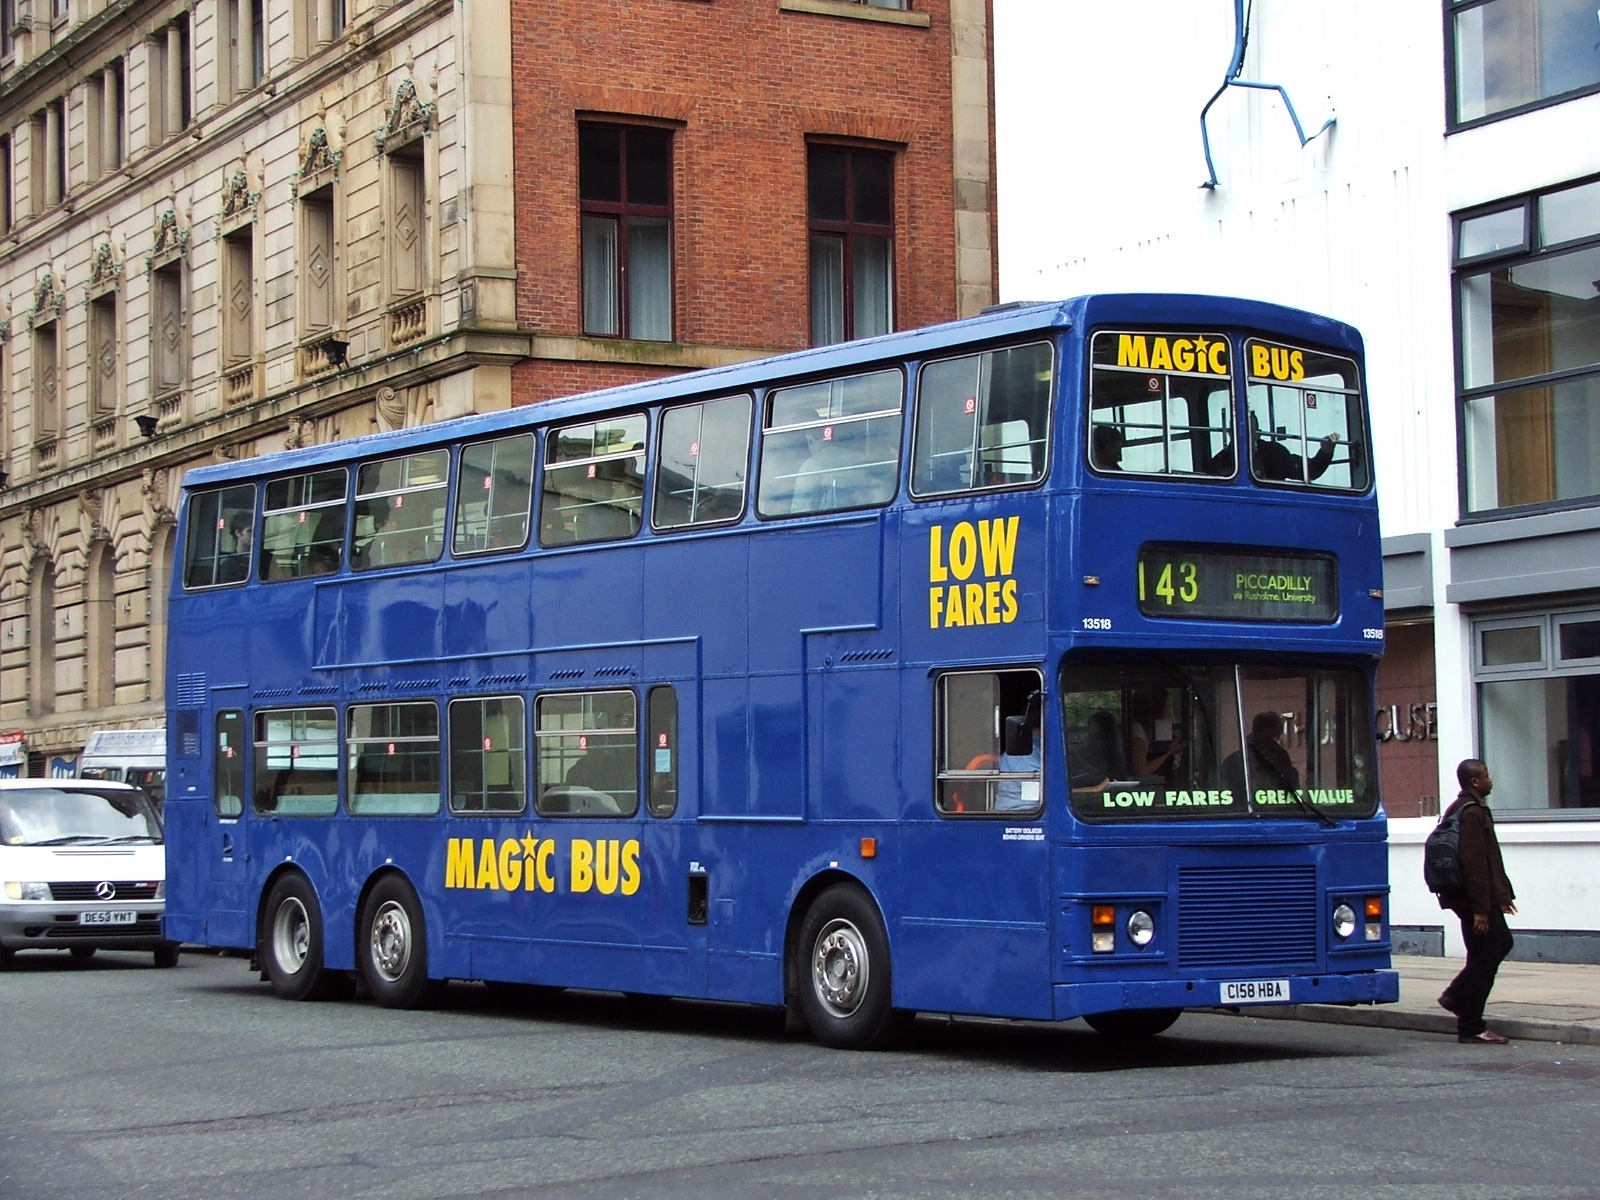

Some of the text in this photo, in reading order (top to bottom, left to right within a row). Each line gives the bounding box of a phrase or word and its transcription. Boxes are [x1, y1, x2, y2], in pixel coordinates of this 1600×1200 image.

[1117, 334, 1305, 381] MAGIC BUS
[930, 516, 1019, 582] LOW
[1138, 561, 1198, 605] 143
[1236, 574, 1311, 591] PICCADILLY
[930, 579, 1018, 629] FARES
[1282, 592, 1316, 604] University
[1082, 618, 1112, 630] 13518
[1362, 628, 1384, 640] 13518
[1103, 792, 1155, 807] LOW
[1165, 790, 1233, 806] FARES
[1308, 790, 1354, 804] VALUE
[445, 829, 641, 895] MAGIC BUS
[85, 912, 133, 923] DE53 YNT
[1227, 982, 1282, 999] C158 HBA
